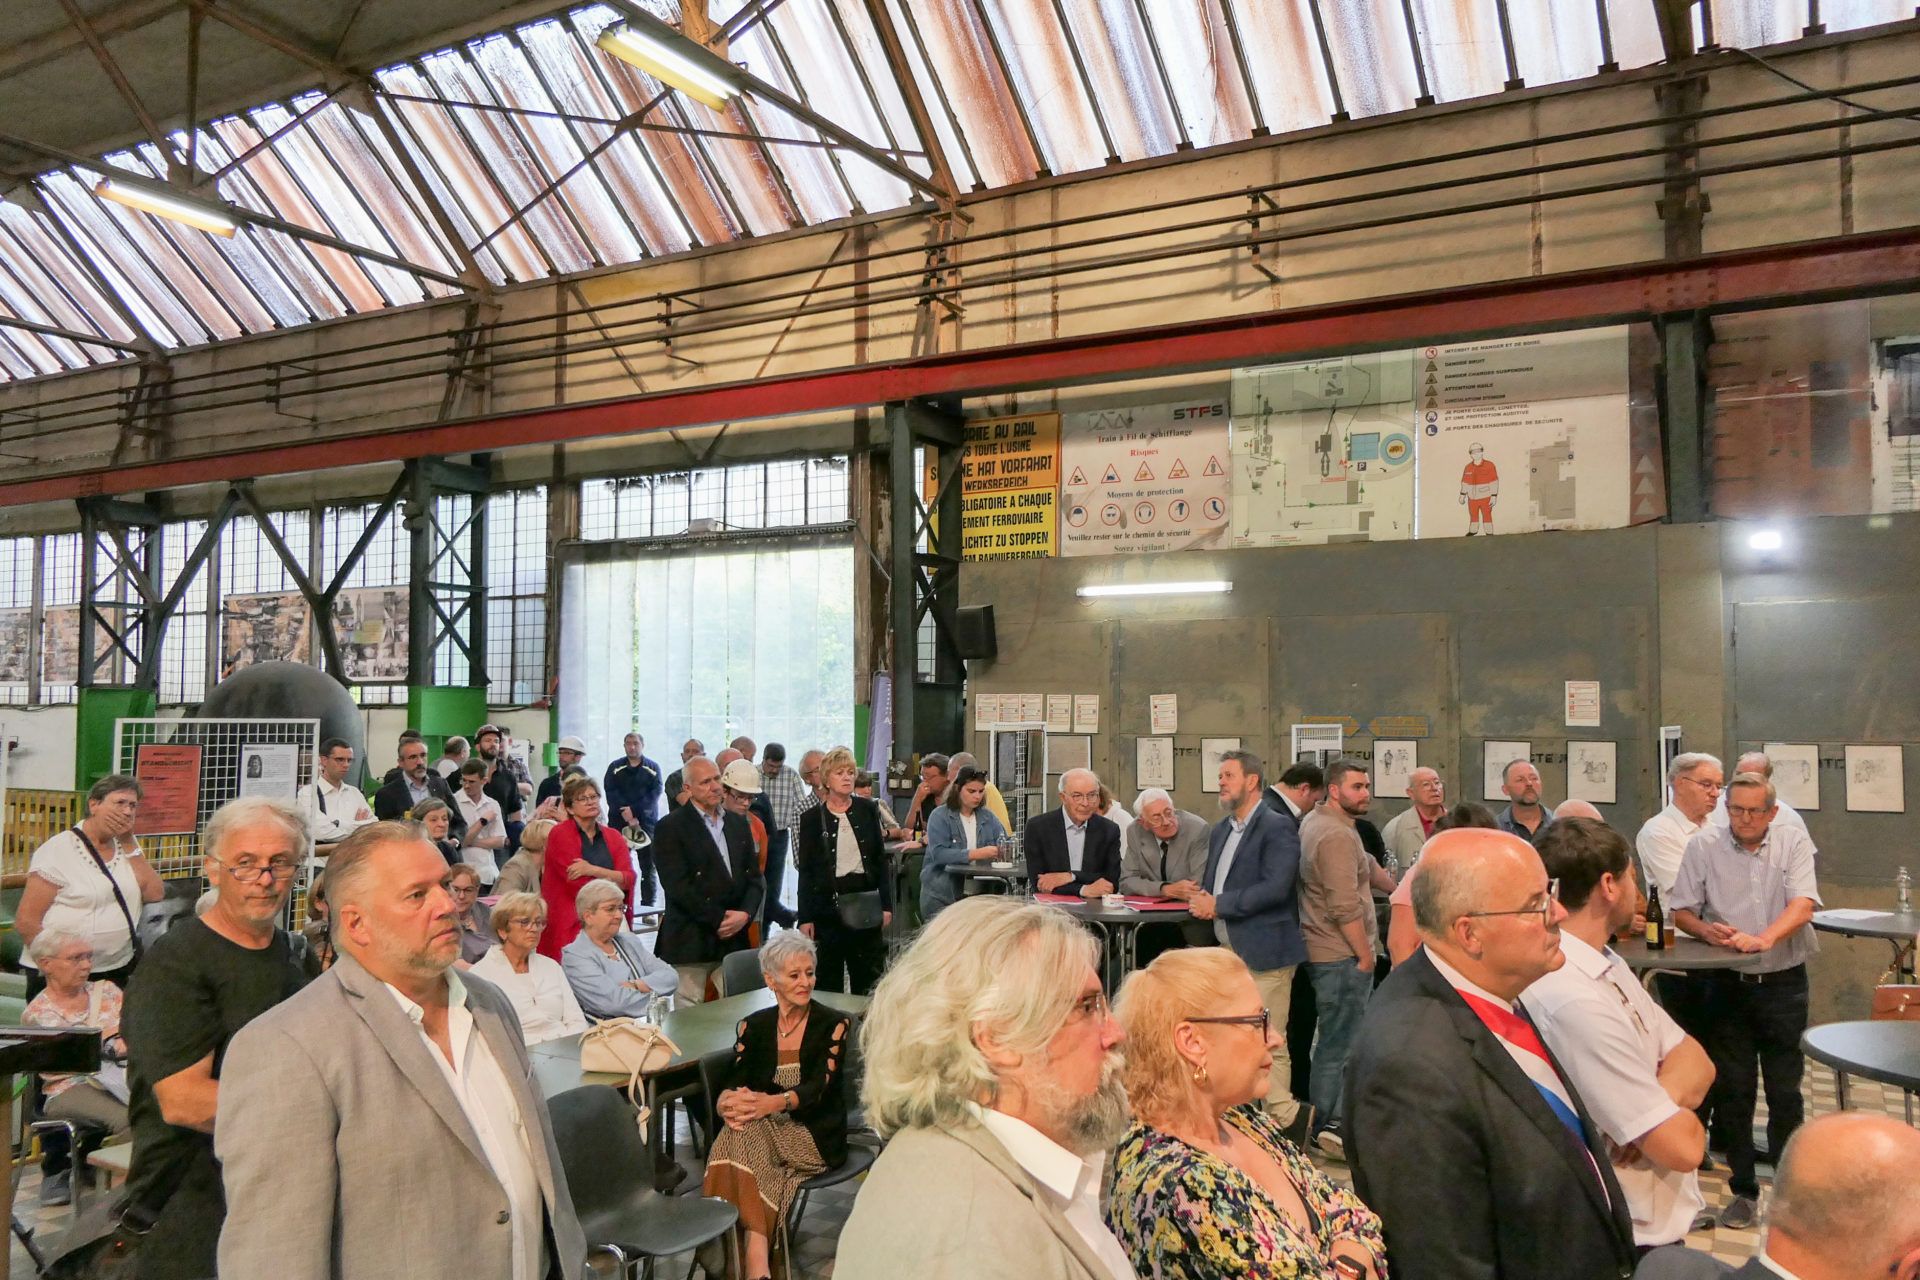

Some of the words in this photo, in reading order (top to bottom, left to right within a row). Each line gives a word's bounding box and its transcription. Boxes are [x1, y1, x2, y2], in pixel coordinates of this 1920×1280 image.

[1174, 404, 1223, 420] STFS
[995, 424, 1008, 439] AU
[1014, 421, 1037, 437] RAIL
[1150, 429, 1192, 438] Schifflange
[975, 443, 997, 456] TOUTE
[1000, 440, 1031, 454] L'USINE
[1130, 448, 1159, 456] Risques
[978, 461, 996, 476] HAT
[1001, 455, 1052, 474] VORFAHRT
[965, 476, 1028, 491] WERKSBEREICH
[1010, 496, 1015, 508] A
[1018, 493, 1052, 508] CHAQUE
[1107, 491, 1133, 499] Moyens
[1147, 488, 1184, 497] protection
[962, 516, 989, 528] EMENT
[992, 512, 1043, 526] FERROVIAIRE
[996, 535, 1006, 547] ZU
[1010, 531, 1048, 546] STOPPEN
[1137, 544, 1165, 552] vigilant
